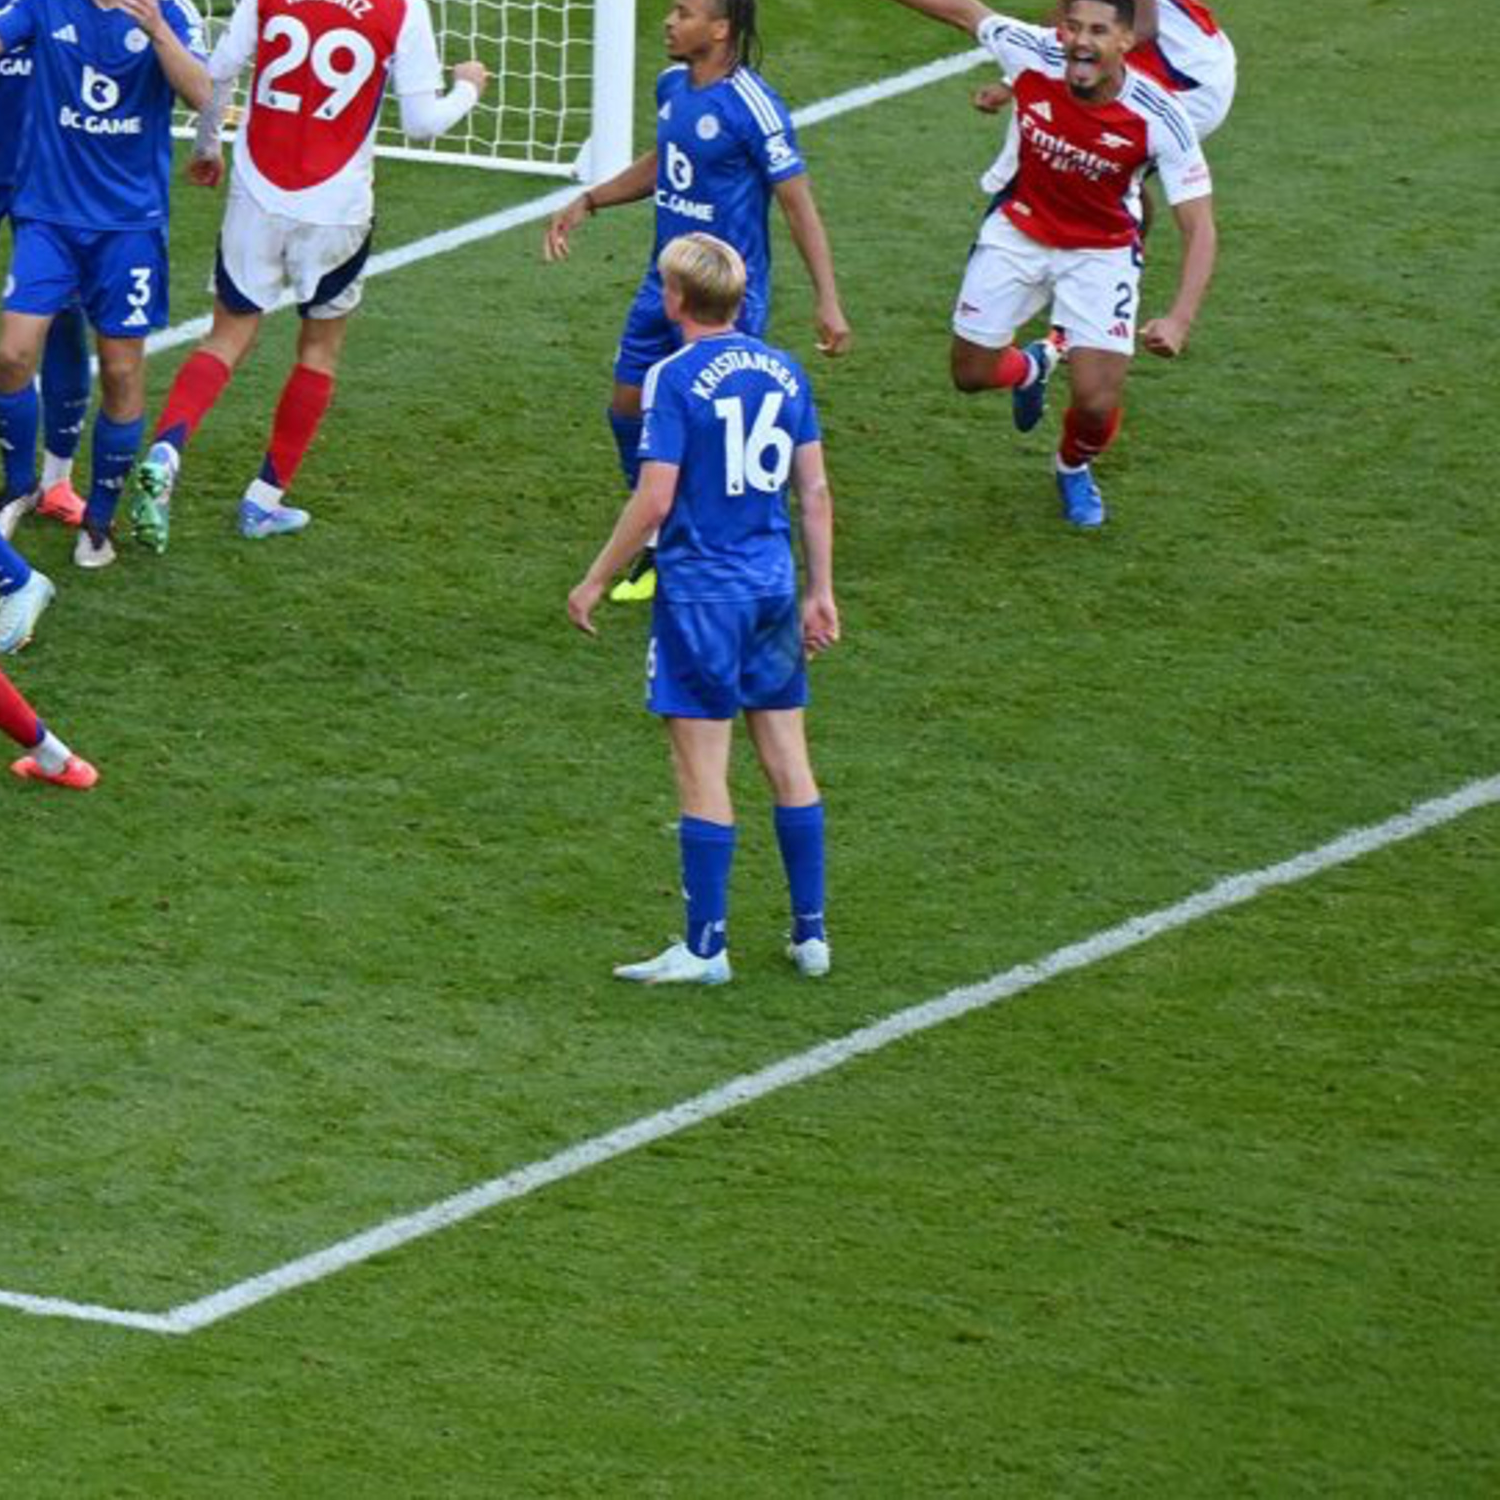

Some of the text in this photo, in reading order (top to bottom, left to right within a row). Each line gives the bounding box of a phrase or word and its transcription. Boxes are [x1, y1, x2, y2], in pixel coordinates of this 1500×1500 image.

[256, 14, 377, 121] 29
[127, 267, 151, 308] 3
[1114, 282, 1132, 320] 2
[690, 350, 799, 400] KRISTIANSEN
[713, 391, 794, 496] 16
